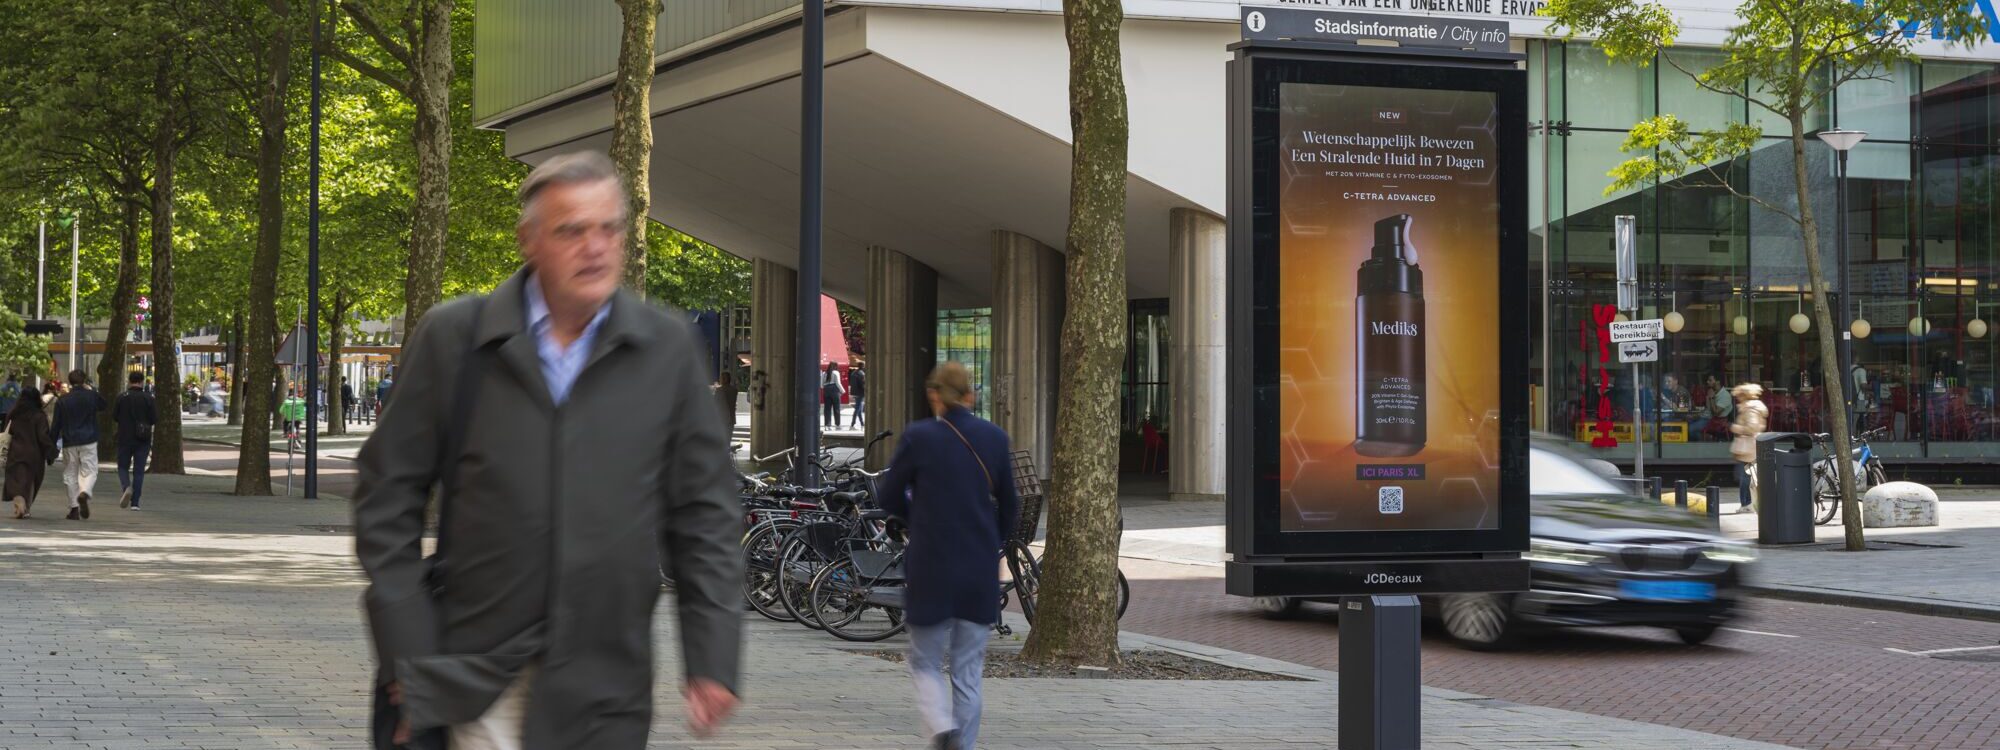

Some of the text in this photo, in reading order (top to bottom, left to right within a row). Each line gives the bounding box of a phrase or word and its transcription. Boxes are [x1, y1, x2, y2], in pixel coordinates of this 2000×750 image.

[1314, 18, 1437, 38] Stadsinformatie
[1440, 25, 1448, 39] /
[1451, 26, 1478, 44] City
[1481, 27, 1505, 43] info
[1379, 111, 1400, 119] NEW
[1303, 131, 1474, 150] Wetenschappelijk Bewezen
[1292, 149, 1485, 170] Een Stralende Huid in 7 Dagen
[1343, 192, 1436, 202] C-TETRA ADVANCED
[1371, 321, 1417, 336] Medik8
[1363, 467, 1420, 477] ICI PARIS XL
[1364, 573, 1422, 584] JCDecaux
